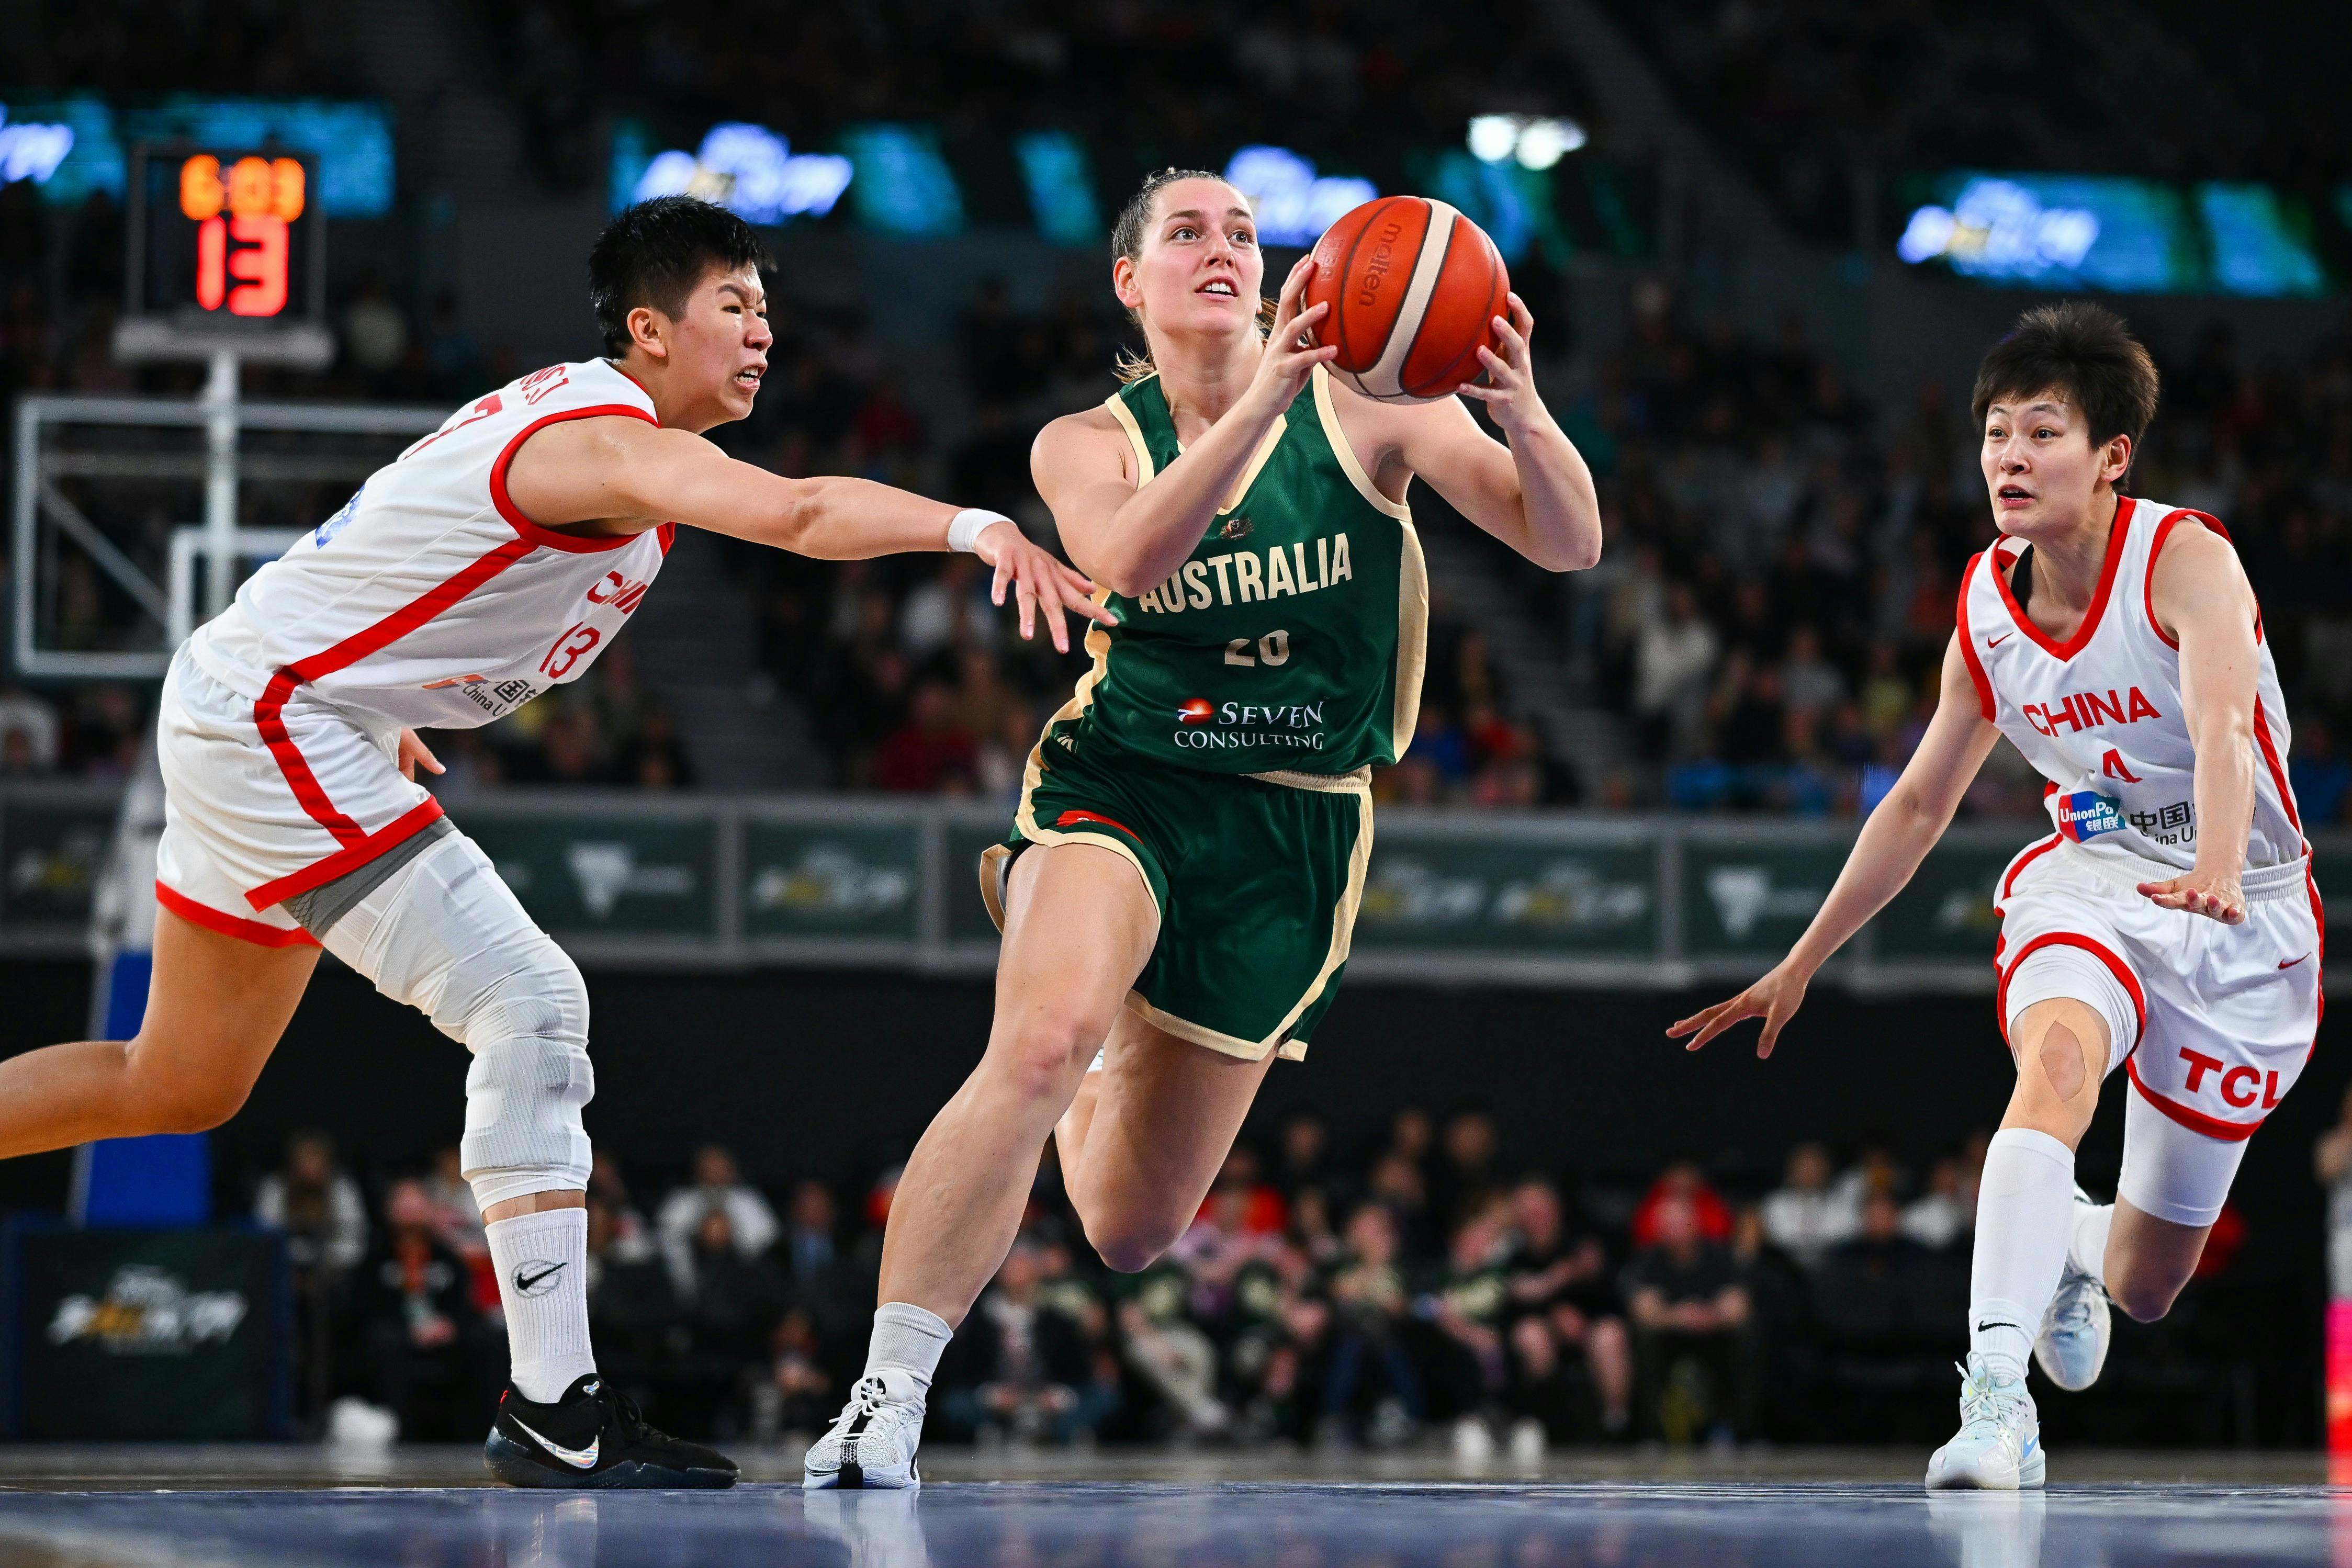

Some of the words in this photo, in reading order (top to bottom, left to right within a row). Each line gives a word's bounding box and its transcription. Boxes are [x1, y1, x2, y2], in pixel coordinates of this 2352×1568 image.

[197, 215, 289, 317] 13
[1358, 223, 1402, 307] molten
[538, 621, 601, 679] 13
[1224, 629, 1290, 667] 20
[463, 684, 493, 711] China
[1218, 701, 1325, 728] SEVEN
[2022, 686, 2162, 737] CHINA
[1174, 730, 1324, 750] CONSULTING
[2086, 816, 2119, 831] 银联
[2130, 801, 2196, 832] 中国
[2179, 1046, 2283, 1110] TCL
